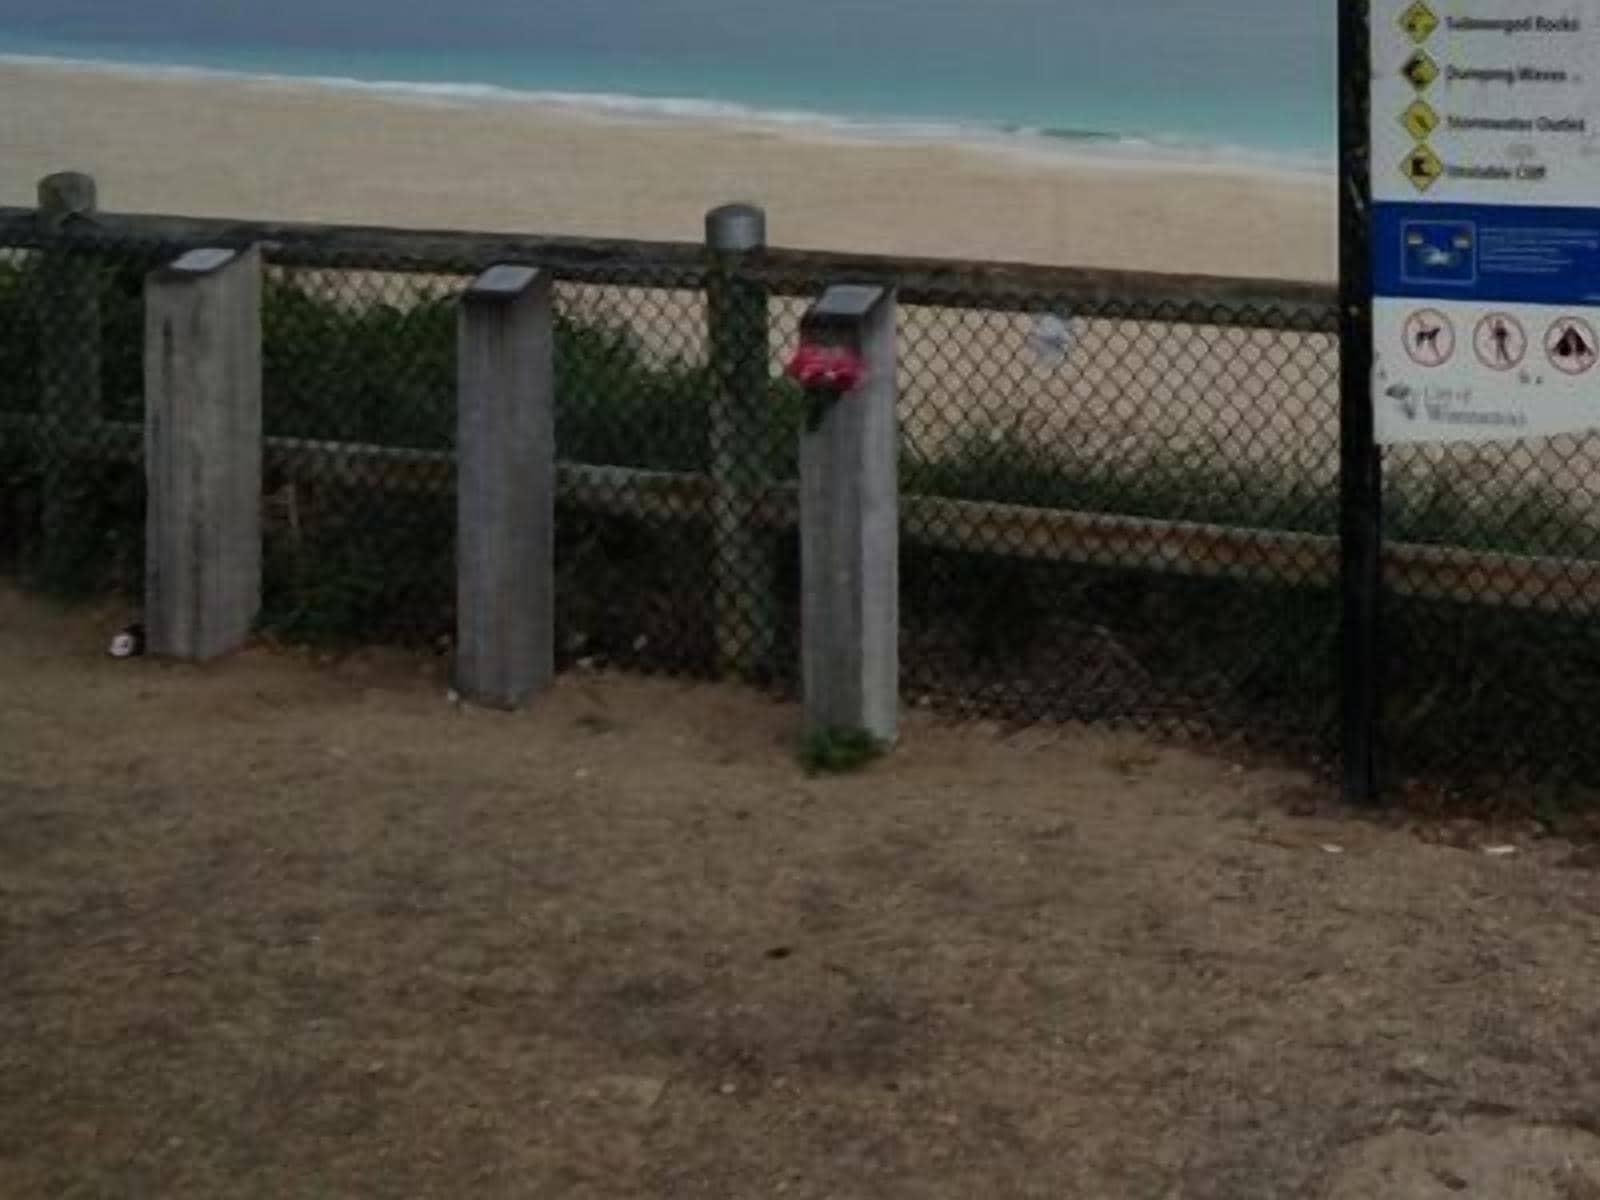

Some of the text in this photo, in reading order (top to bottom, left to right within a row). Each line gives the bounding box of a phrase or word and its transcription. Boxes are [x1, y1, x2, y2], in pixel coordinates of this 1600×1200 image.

[1536, 15, 1579, 31] Rocks
[1447, 65, 1515, 85] Dumping
[1447, 116, 1532, 130] Stormwater
